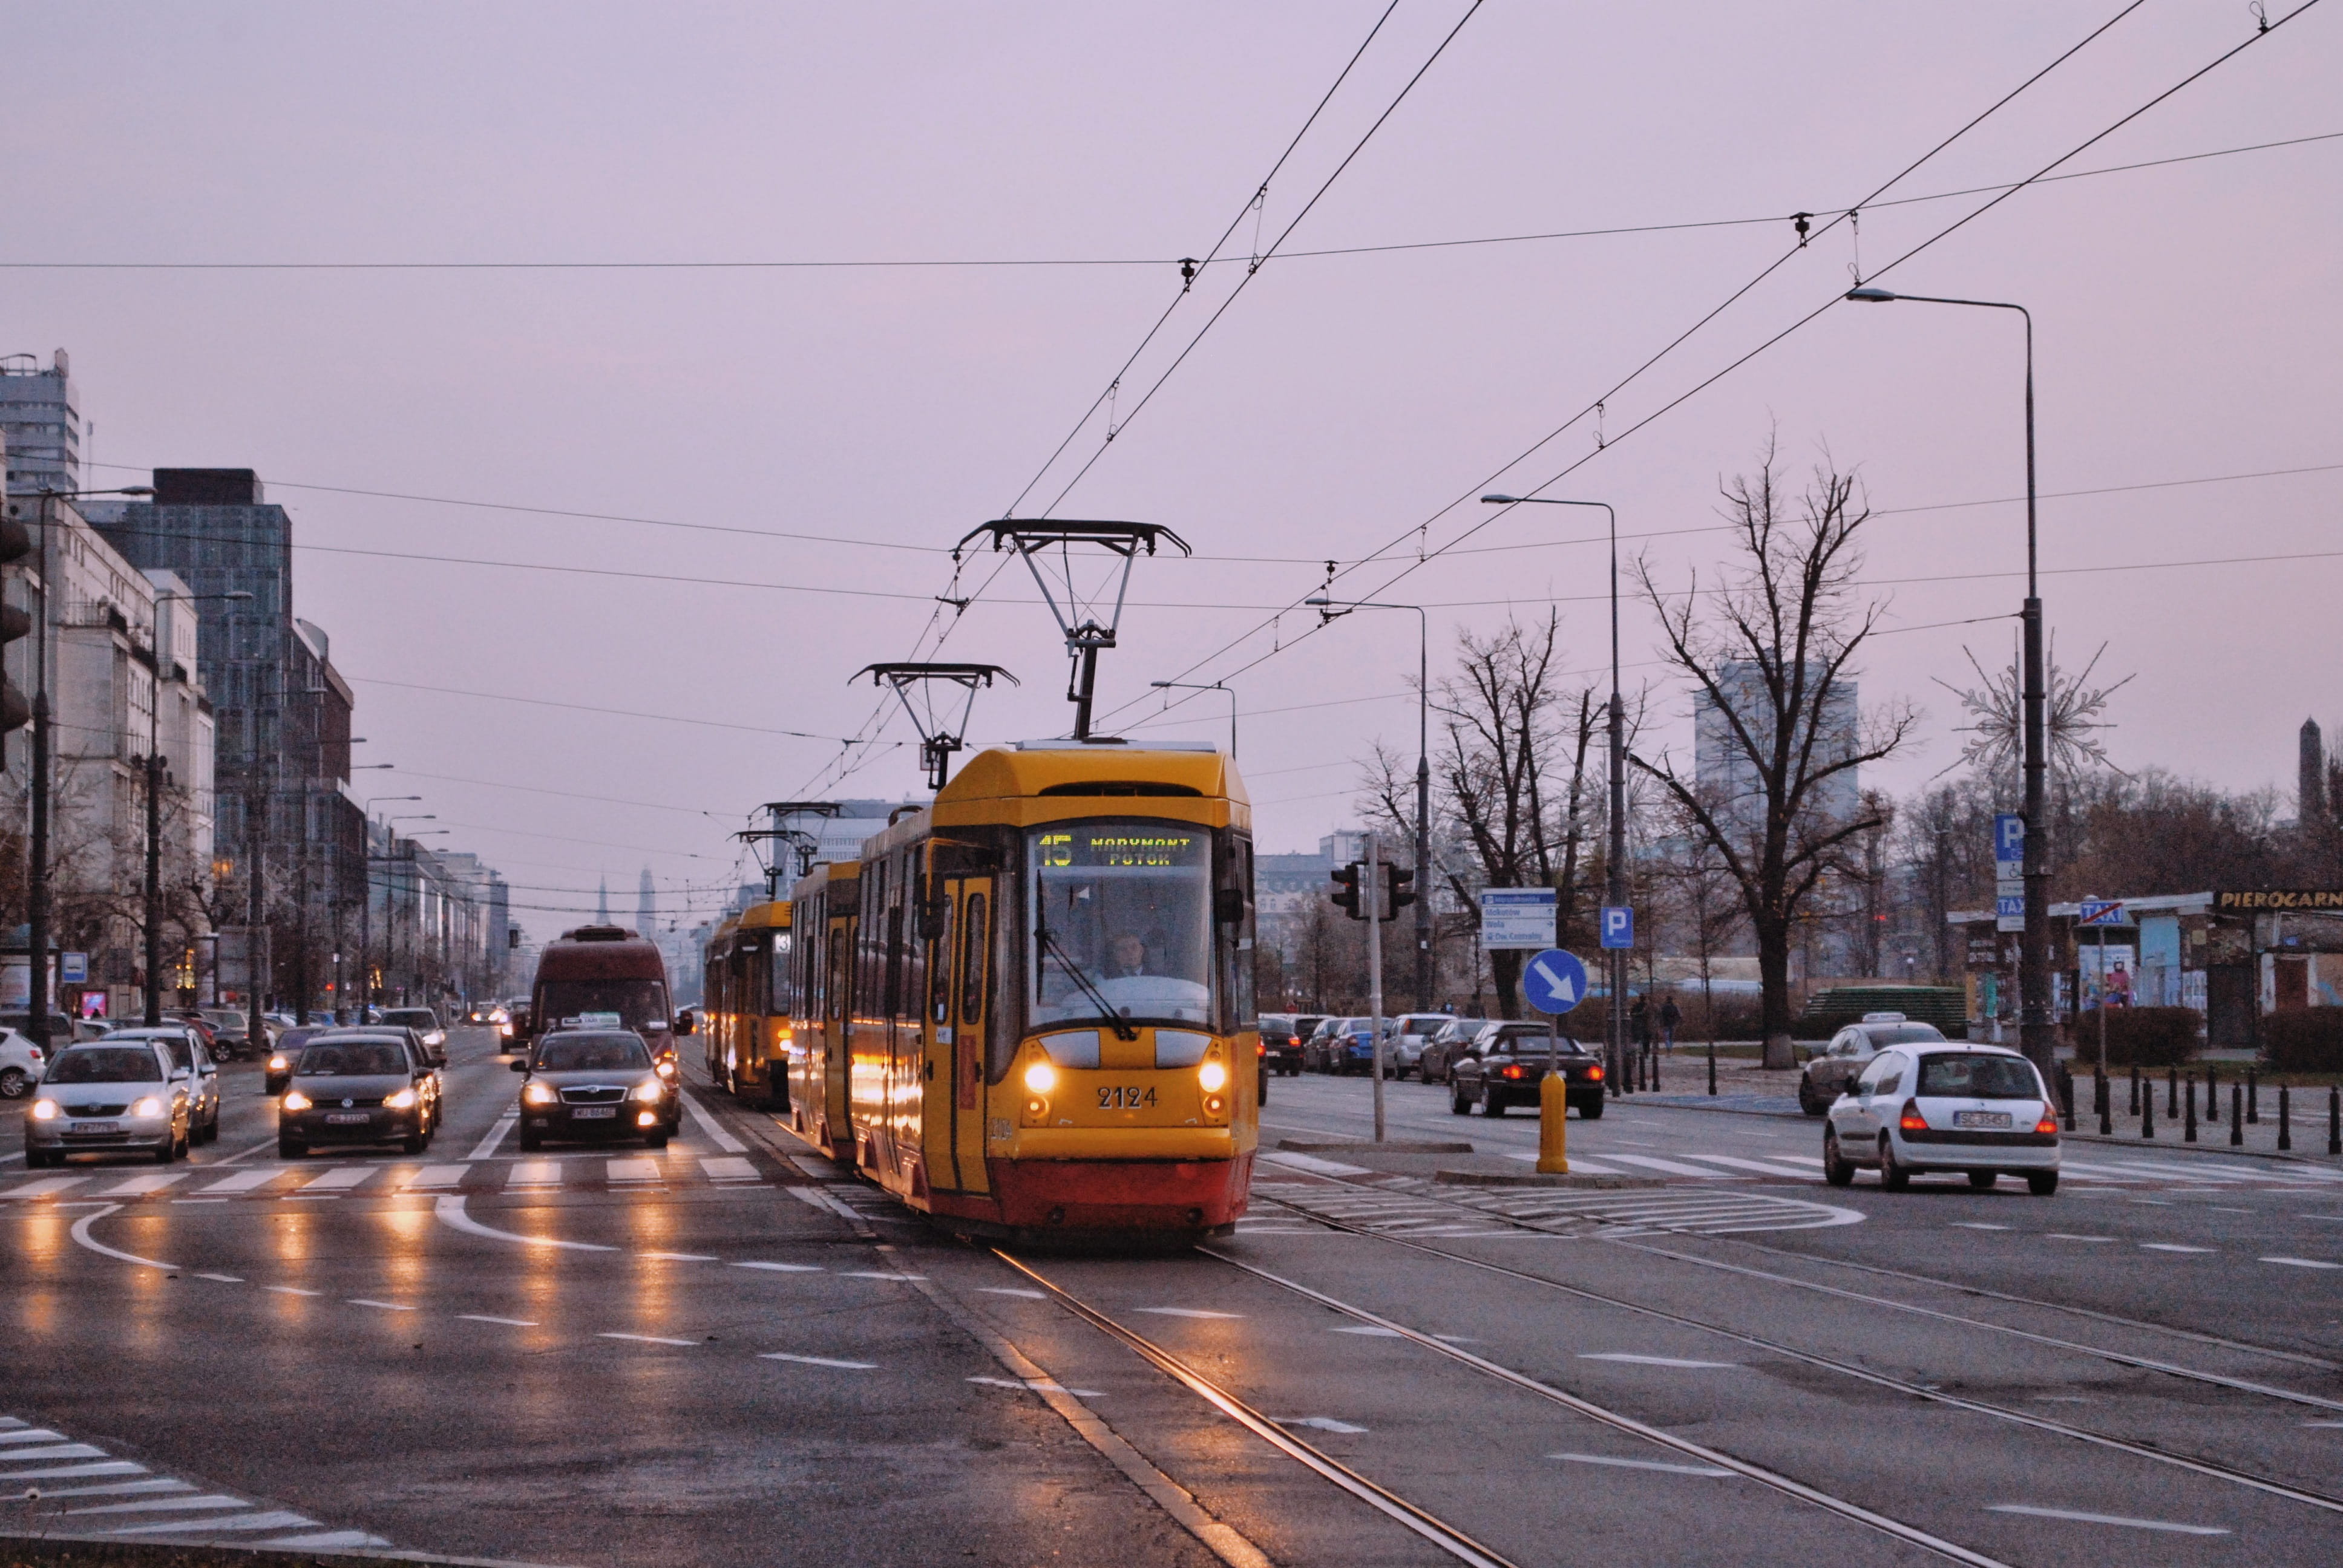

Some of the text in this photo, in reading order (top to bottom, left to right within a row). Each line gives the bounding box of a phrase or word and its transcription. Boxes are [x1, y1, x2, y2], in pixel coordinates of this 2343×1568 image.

[2004, 818, 2025, 848] P
[1040, 834, 1072, 866] 15
[1091, 838, 1190, 852] MARYMONT
[1110, 853, 1170, 865] POTOK
[1608, 912, 1627, 936] P
[2083, 904, 2122, 922] TAXI
[1098, 1086, 1158, 1109] 2124
